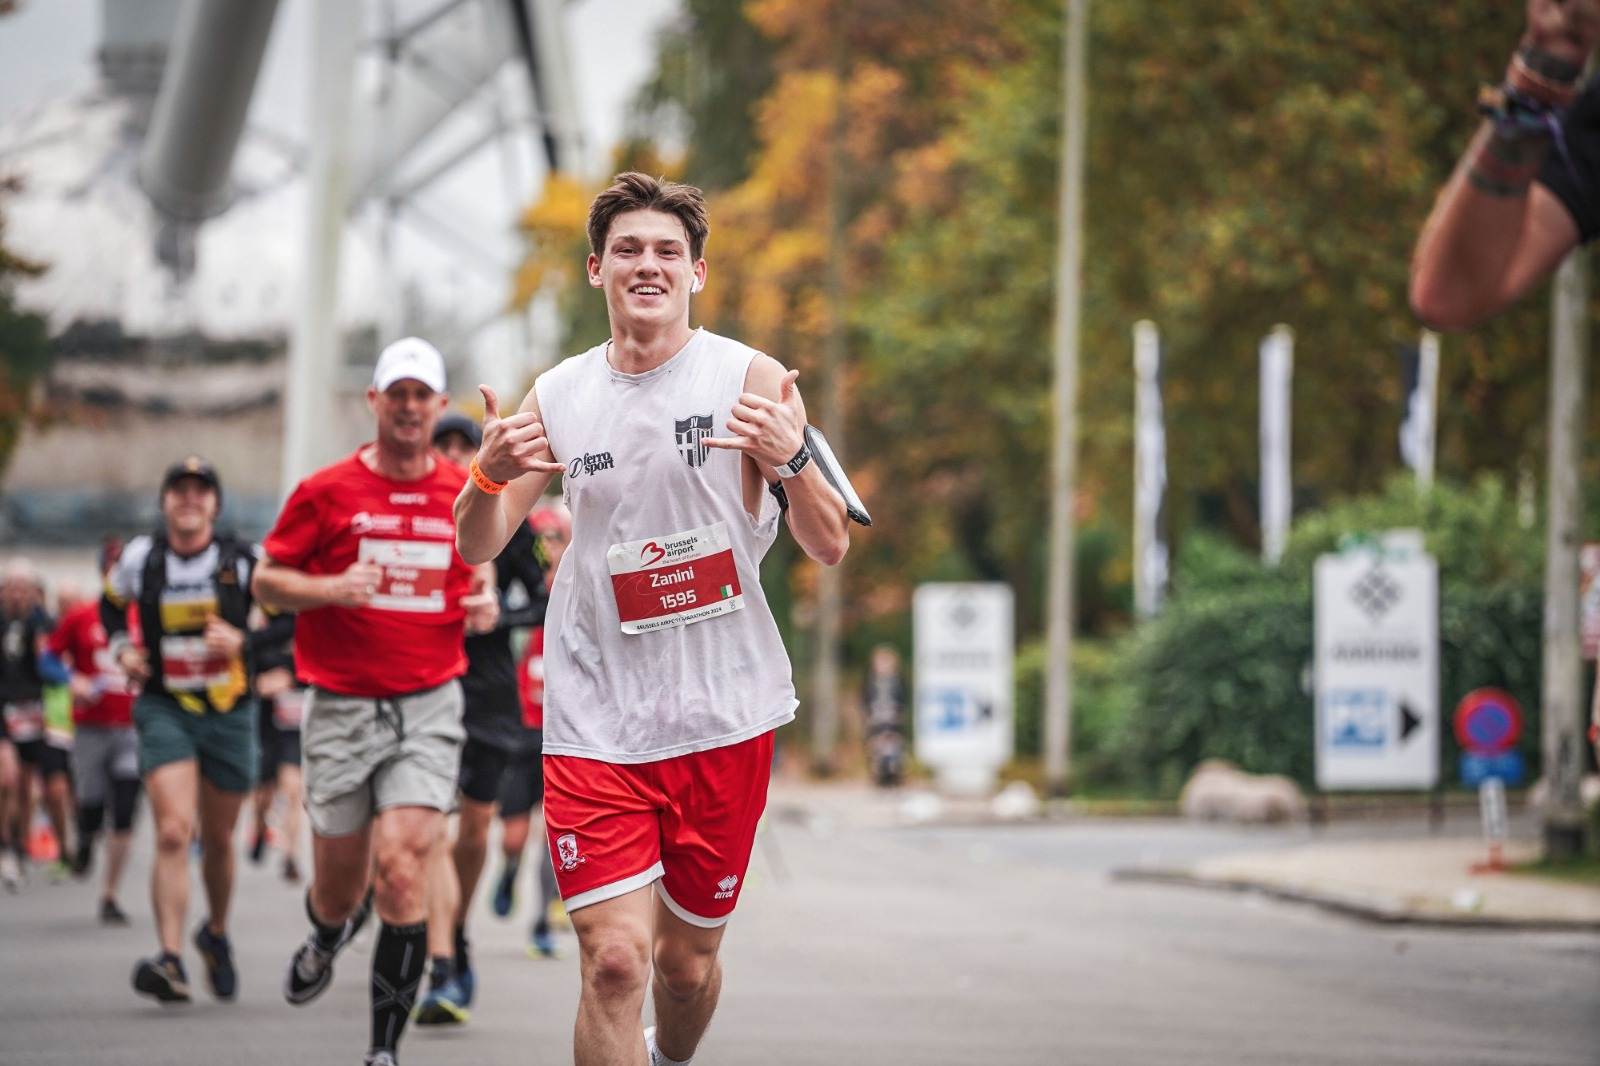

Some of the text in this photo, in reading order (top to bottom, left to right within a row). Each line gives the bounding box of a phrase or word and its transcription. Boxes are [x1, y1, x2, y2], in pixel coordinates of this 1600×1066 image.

[583, 451, 611, 466] ferro
[585, 457, 615, 476] sport
[664, 536, 698, 550] brussels
[667, 545, 694, 558] airport
[649, 566, 695, 588] Zanini
[660, 590, 697, 609] 1595
